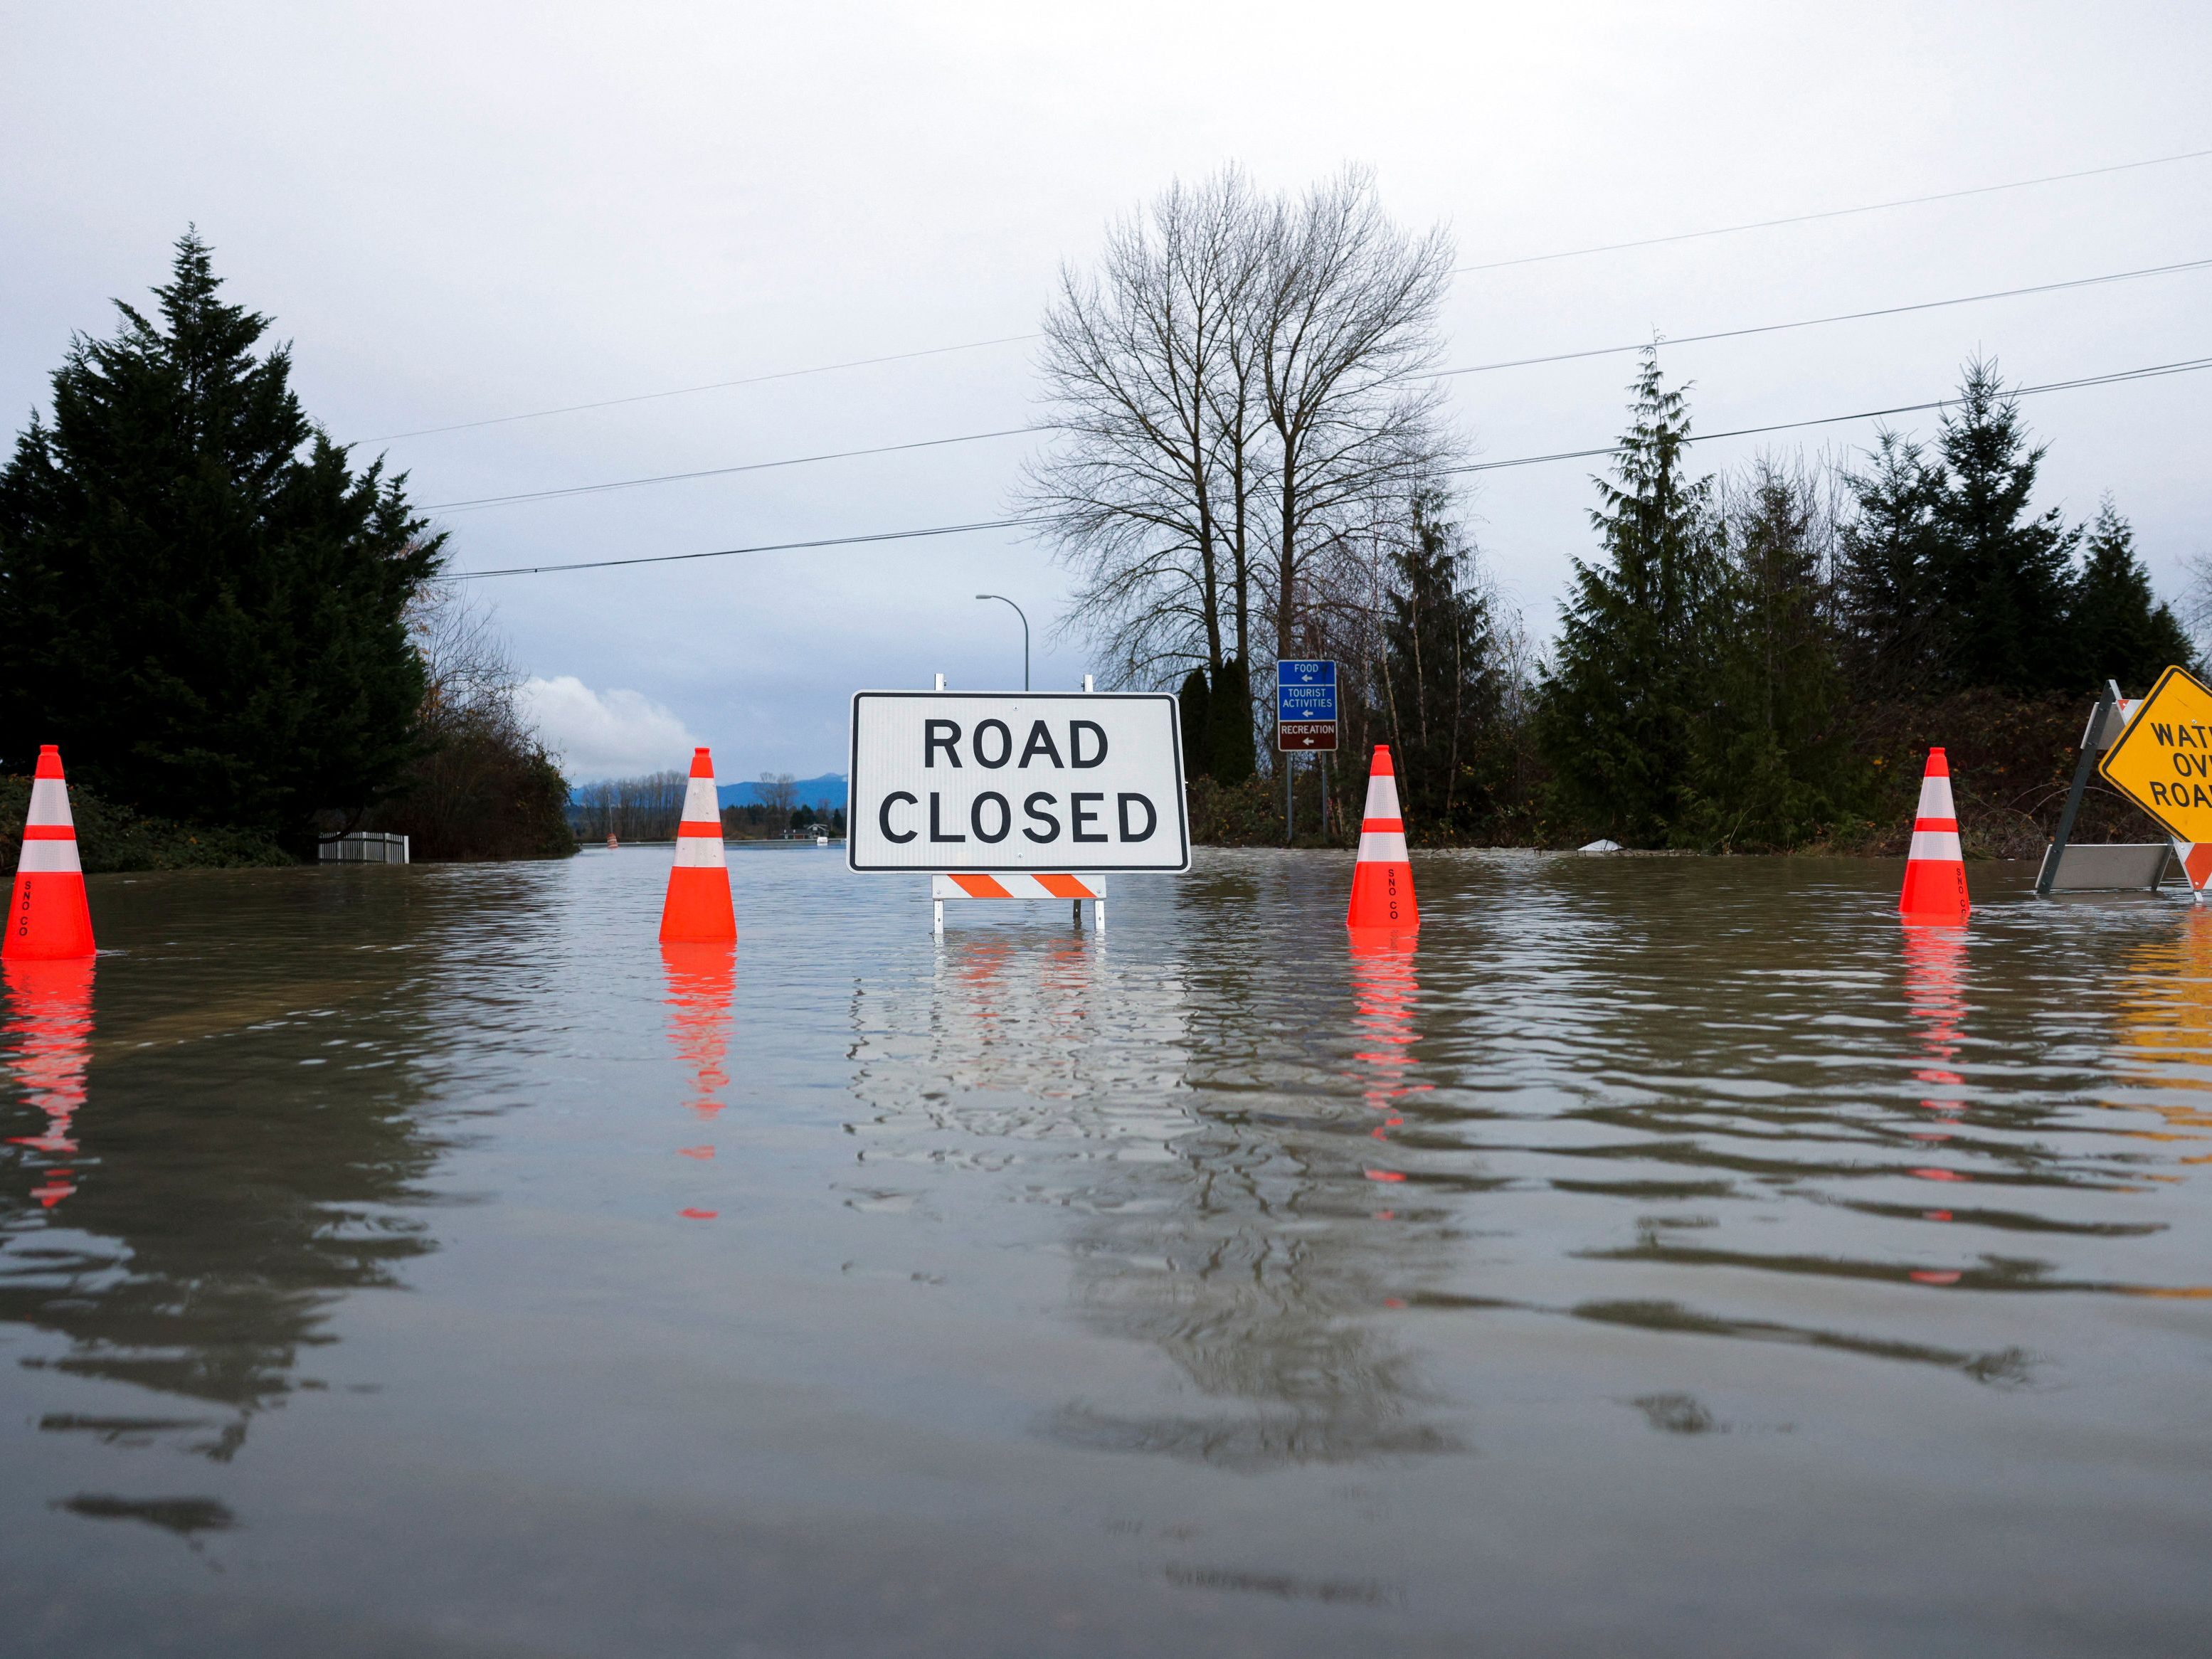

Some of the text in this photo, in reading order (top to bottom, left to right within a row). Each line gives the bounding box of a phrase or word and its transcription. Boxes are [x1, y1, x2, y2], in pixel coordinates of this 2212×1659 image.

[1294, 664, 1318, 672] FOOD
[1283, 699, 1333, 707] ACTIVITIES
[1288, 688, 1325, 697] TOURIST
[1281, 725, 1335, 734] RECREATION
[2150, 722, 2212, 748] WAT
[924, 718, 1108, 769] ROAD
[2173, 753, 2212, 778] OV
[2149, 781, 2212, 808] ROA
[879, 790, 1158, 844] CLOSED
[1388, 869, 1398, 920] SNO CO
[18, 881, 31, 936] SNO CO
